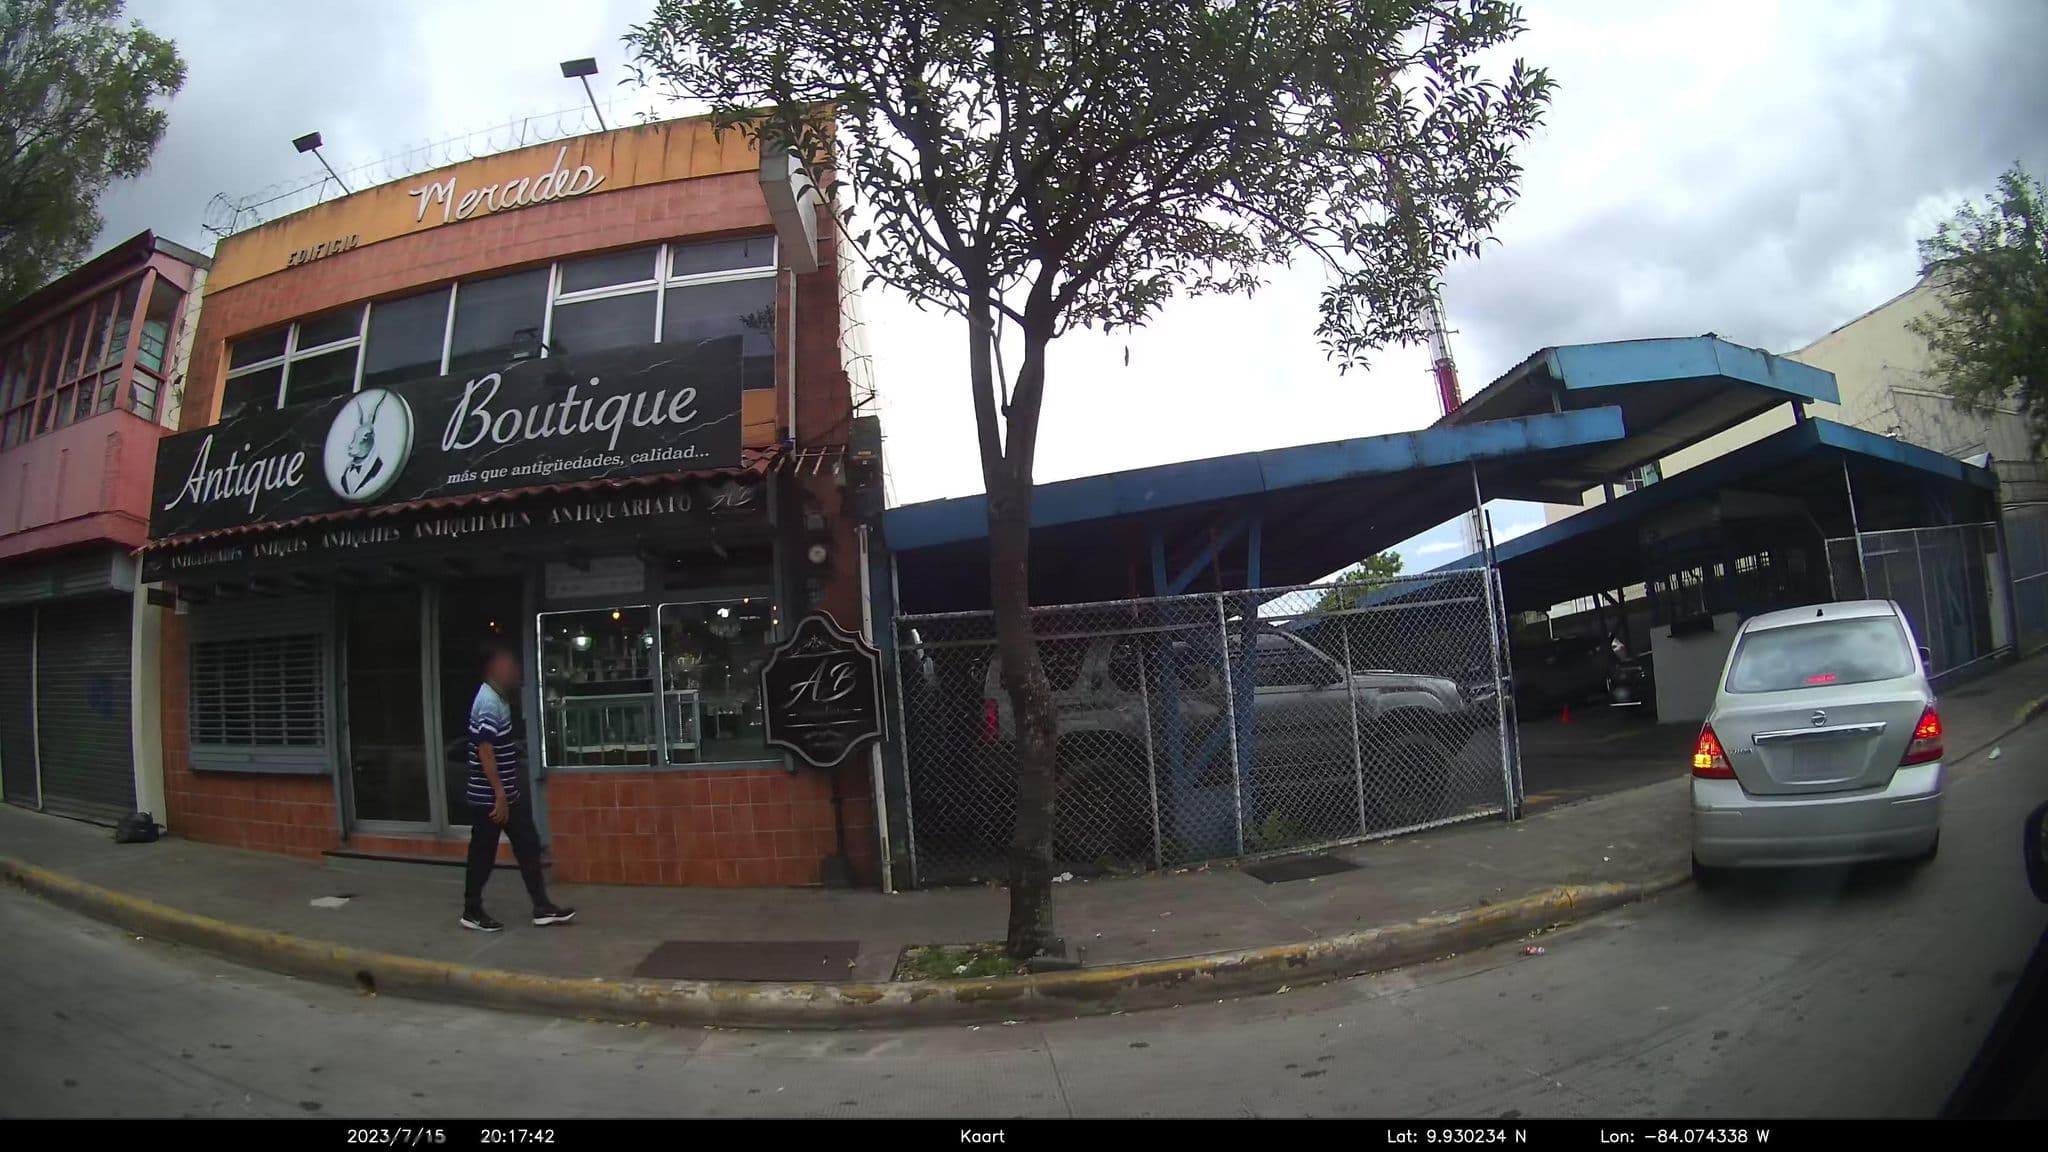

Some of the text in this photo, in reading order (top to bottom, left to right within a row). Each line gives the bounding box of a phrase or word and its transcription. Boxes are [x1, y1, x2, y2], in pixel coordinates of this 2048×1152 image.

[287, 234, 360, 267] EDIFICIO
[163, 372, 699, 514] Antique Boutique
[447, 445, 710, 485] más que antigüedades, calidad...
[551, 495, 692, 524] ANTIQUARIATO
